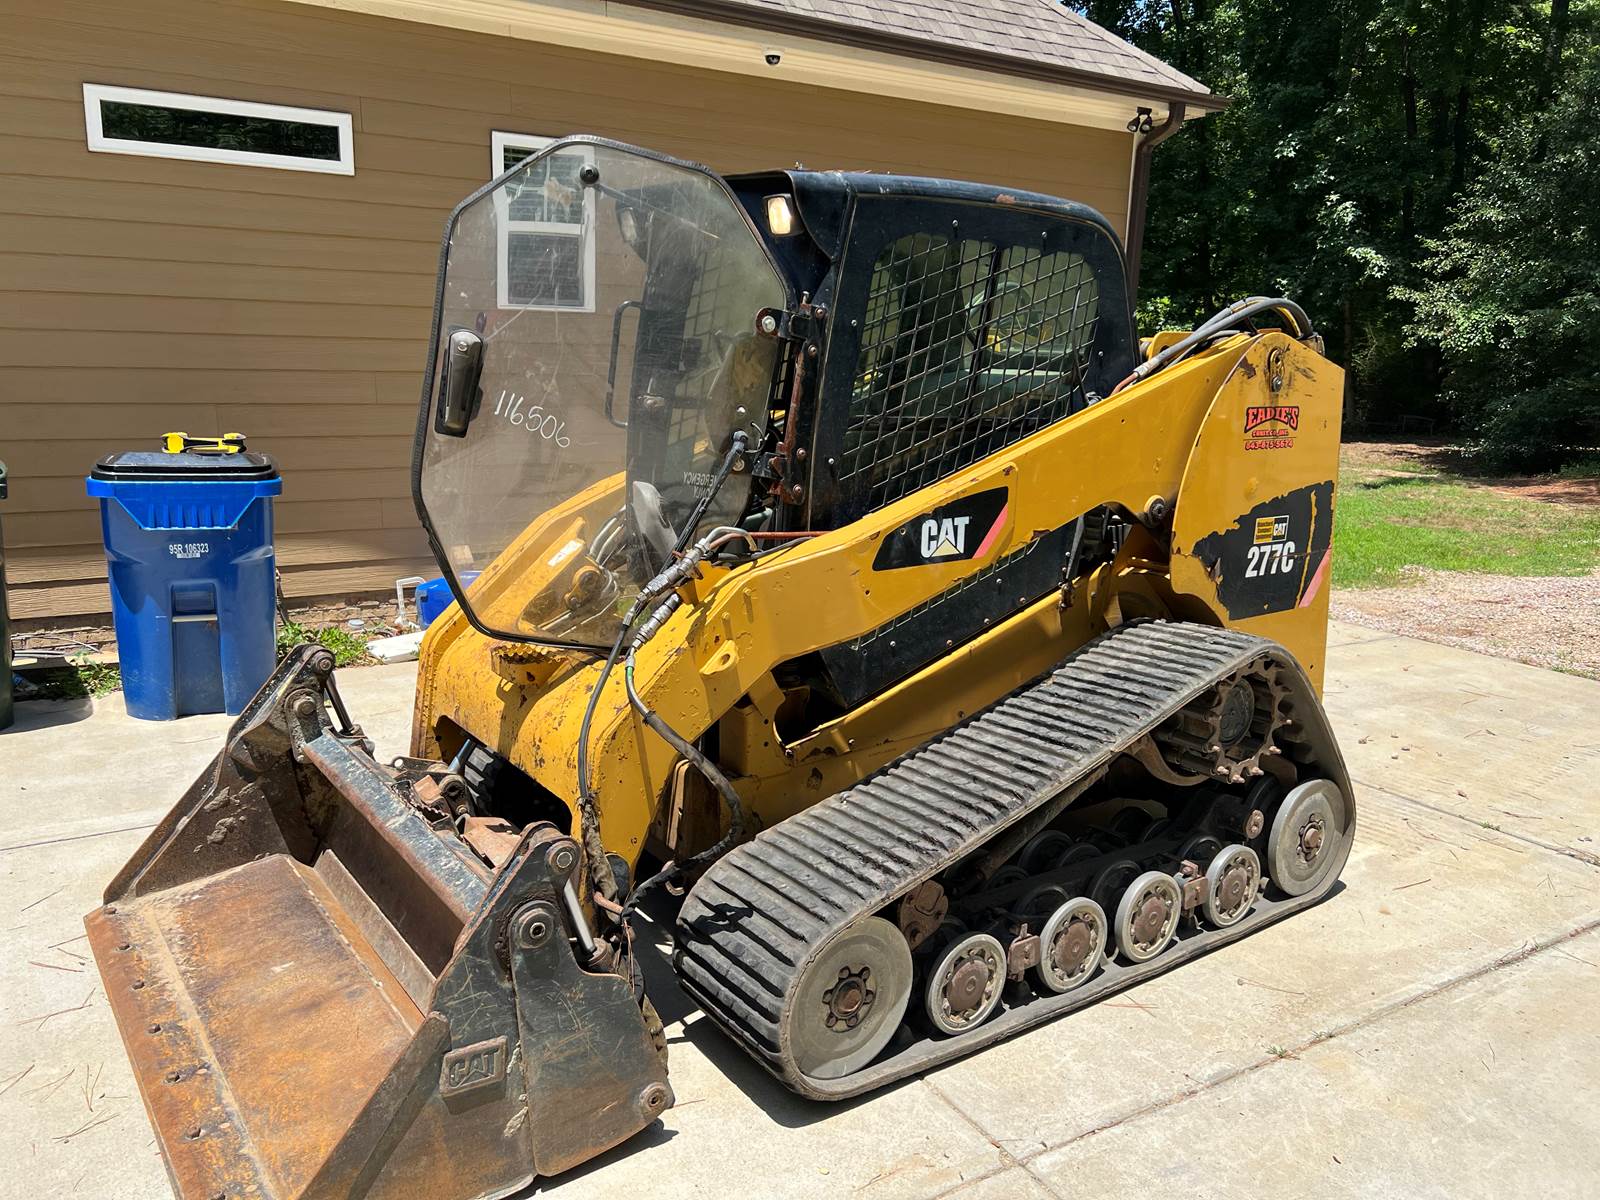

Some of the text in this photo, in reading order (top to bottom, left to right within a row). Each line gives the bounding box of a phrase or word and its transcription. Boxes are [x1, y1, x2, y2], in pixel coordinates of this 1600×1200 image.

[494, 390, 570, 448] 116506
[1244, 406, 1299, 433] EADIE'S
[920, 515, 970, 558] CAT
[1273, 523, 1288, 537] CAT
[168, 543, 209, 555] 95R 106323
[1245, 541, 1296, 578] 277C
[448, 1048, 499, 1088] CAT
